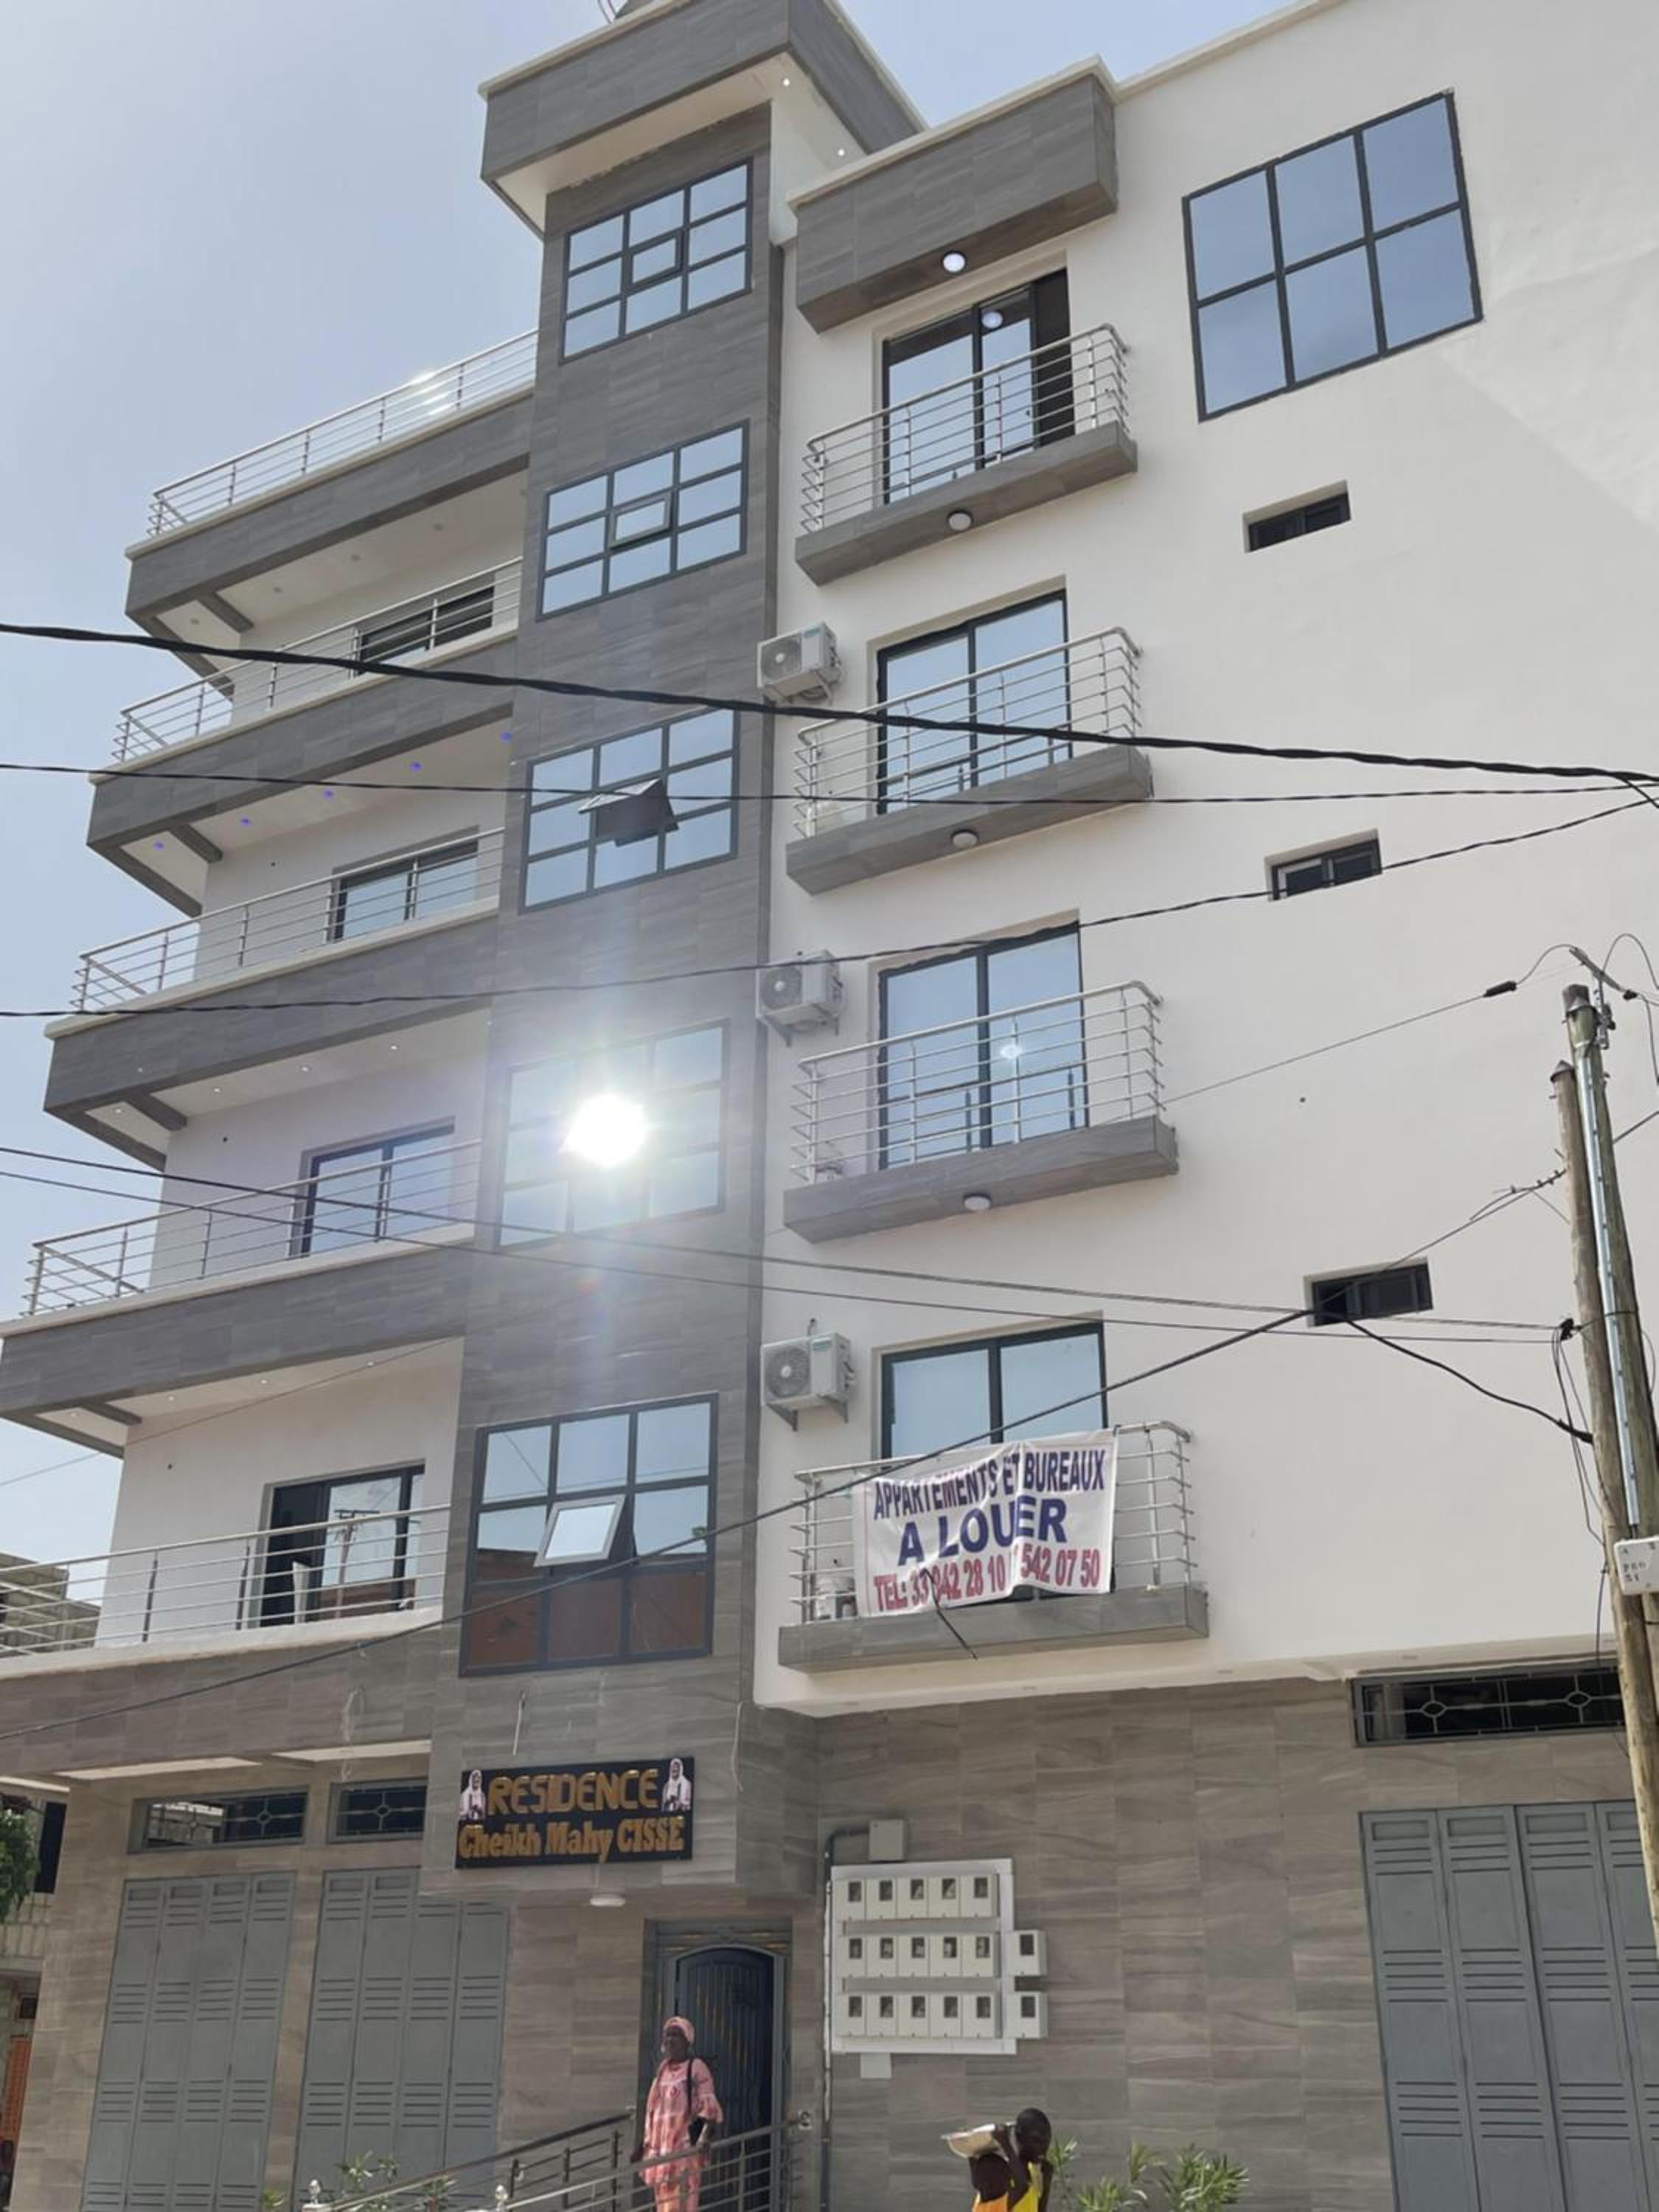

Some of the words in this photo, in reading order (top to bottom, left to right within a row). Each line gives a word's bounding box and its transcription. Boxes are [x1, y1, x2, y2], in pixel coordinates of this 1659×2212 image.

[1003, 1453, 1020, 1495] ET
[1023, 1449, 1106, 1490] BUREAUX
[898, 1521, 925, 1566] A
[939, 1495, 1067, 1557] LOUER
[964, 1558, 984, 1597] 28
[988, 1554, 1006, 1592] 10
[1056, 1549, 1077, 1586] 07
[1081, 1548, 1101, 1587] 50
[487, 1769, 659, 1815] RESIDENCE
[458, 1824, 542, 1858] Cheikh
[546, 1820, 613, 1863] Mahy
[616, 1815, 686, 1851] CISSE
